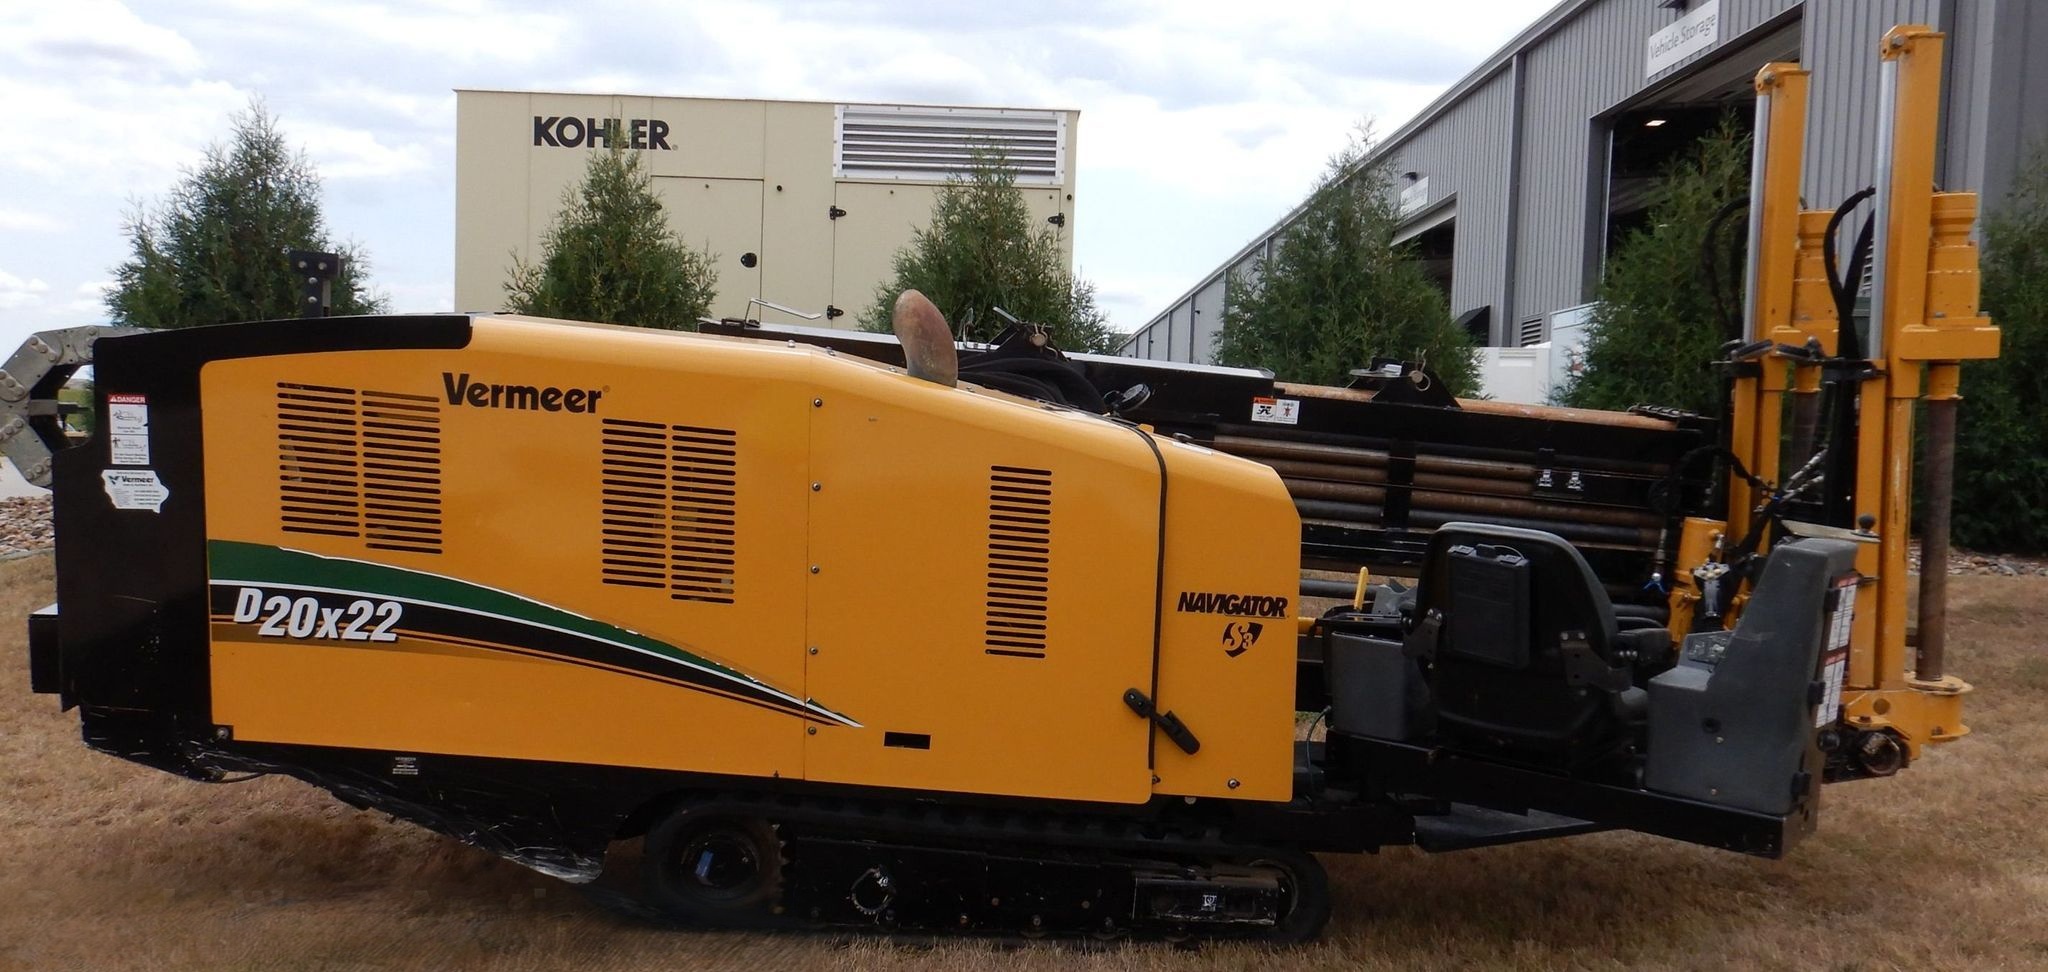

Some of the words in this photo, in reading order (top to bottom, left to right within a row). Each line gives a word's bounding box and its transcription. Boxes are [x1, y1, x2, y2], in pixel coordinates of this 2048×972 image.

[1650, 32, 1680, 60] Vehicle
[1681, 14, 1717, 44] Storage
[533, 116, 672, 150] KOHLER
[116, 396, 146, 404] DANGER
[442, 372, 602, 414] Vermeer
[122, 475, 154, 484] Vermeer
[233, 587, 403, 642] D20x22
[1177, 592, 1289, 618] NAVIGATOR
